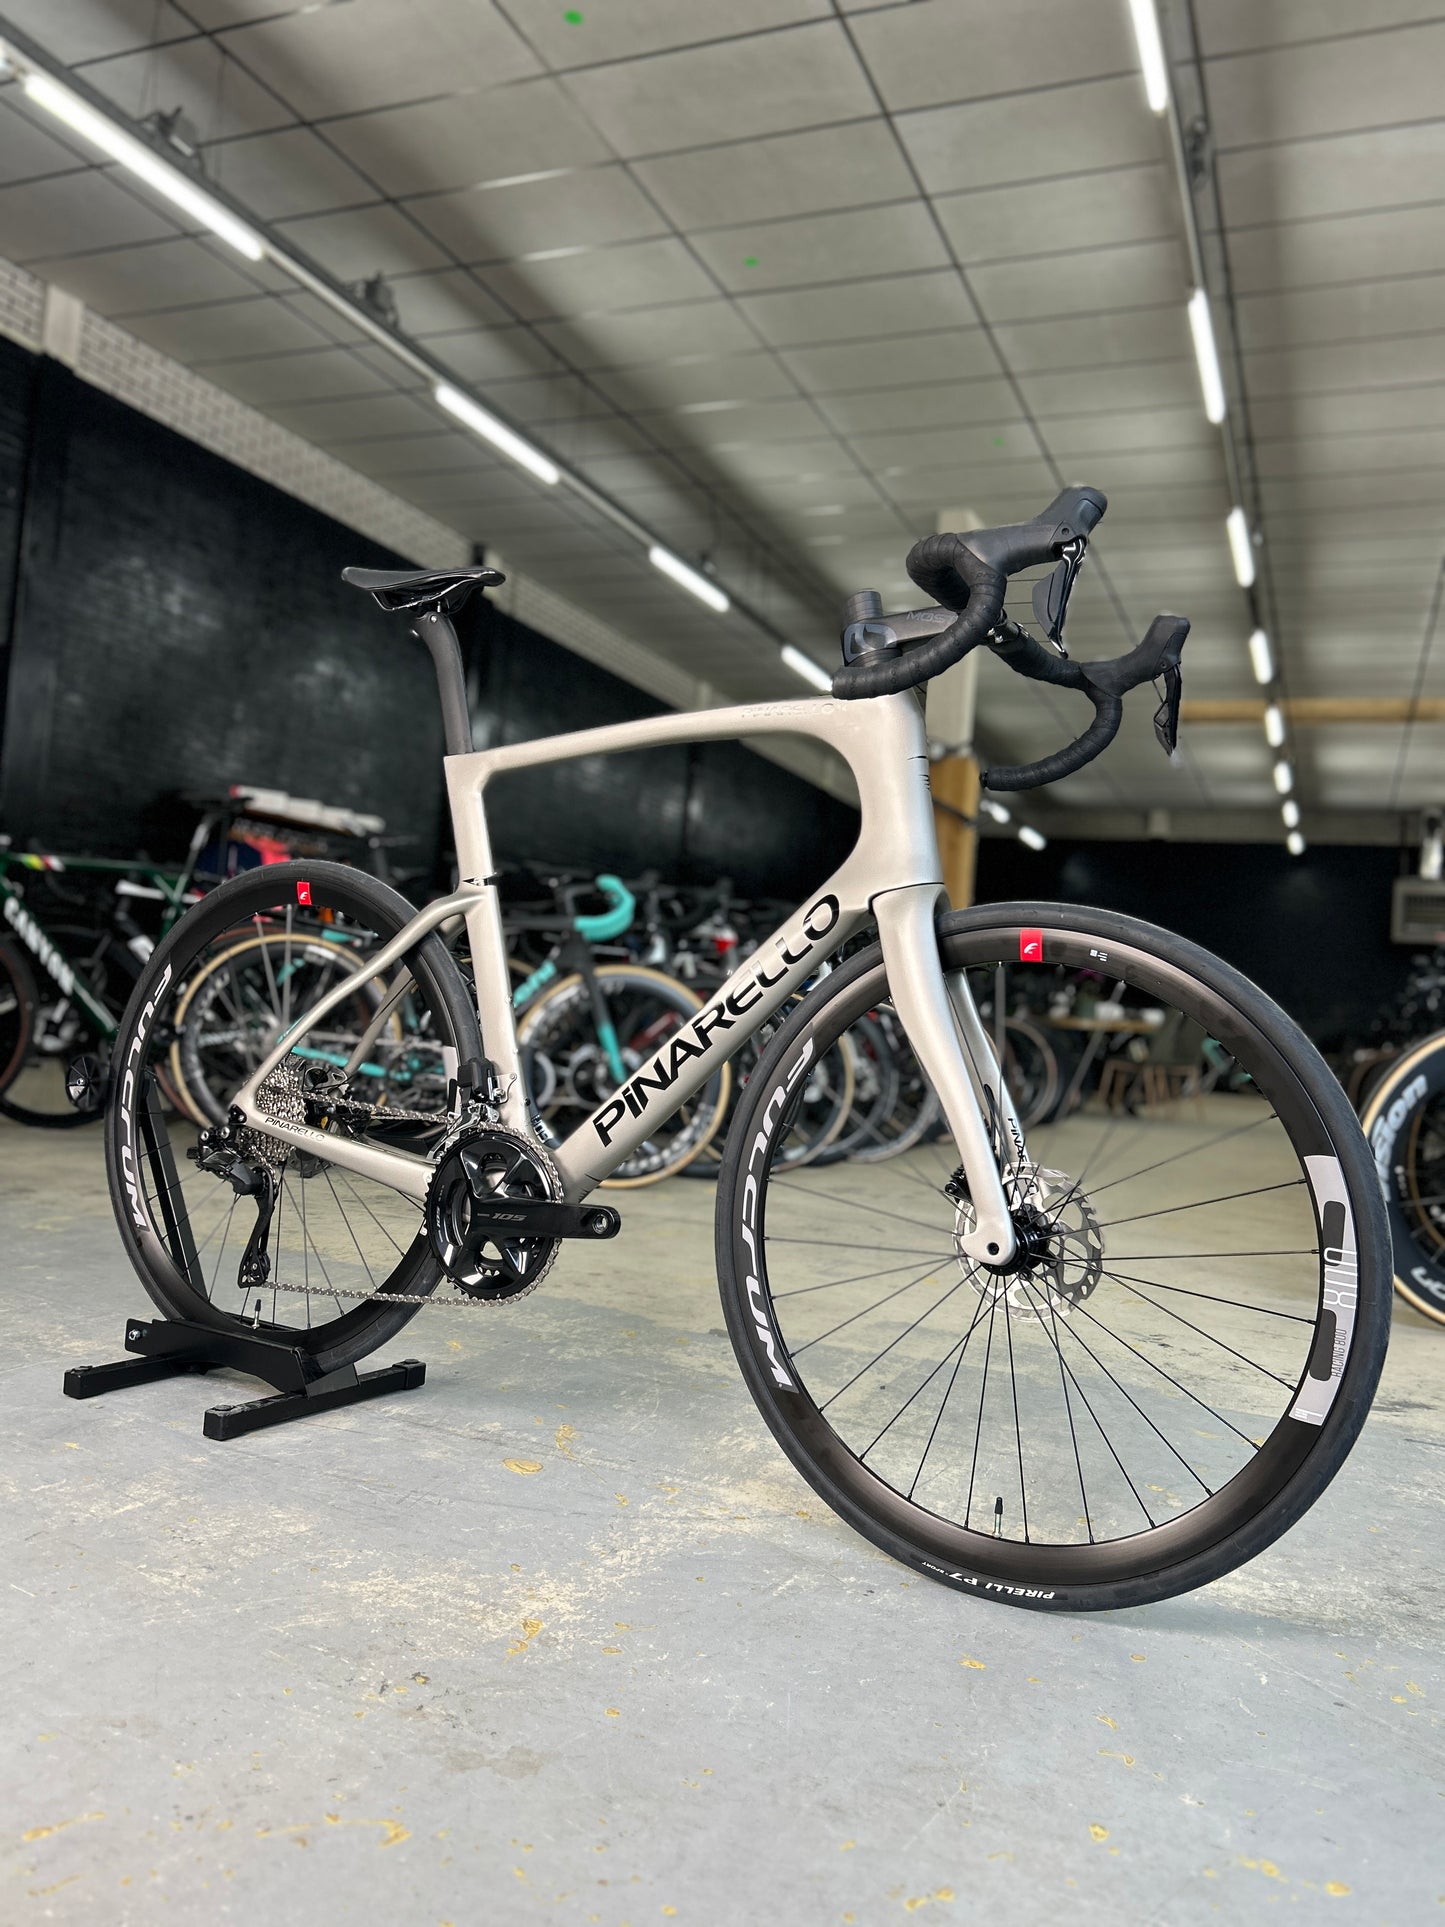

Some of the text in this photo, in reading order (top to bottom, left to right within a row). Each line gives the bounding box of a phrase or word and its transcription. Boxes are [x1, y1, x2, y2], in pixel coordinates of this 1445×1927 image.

[592, 893, 841, 1148] PINARELLO
[264, 1116, 326, 1141] PINARELLO
[492, 1212, 527, 1221] 105
[1331, 1348, 1346, 1377] RACING
[985, 1582, 1056, 1600] PIRELLI
